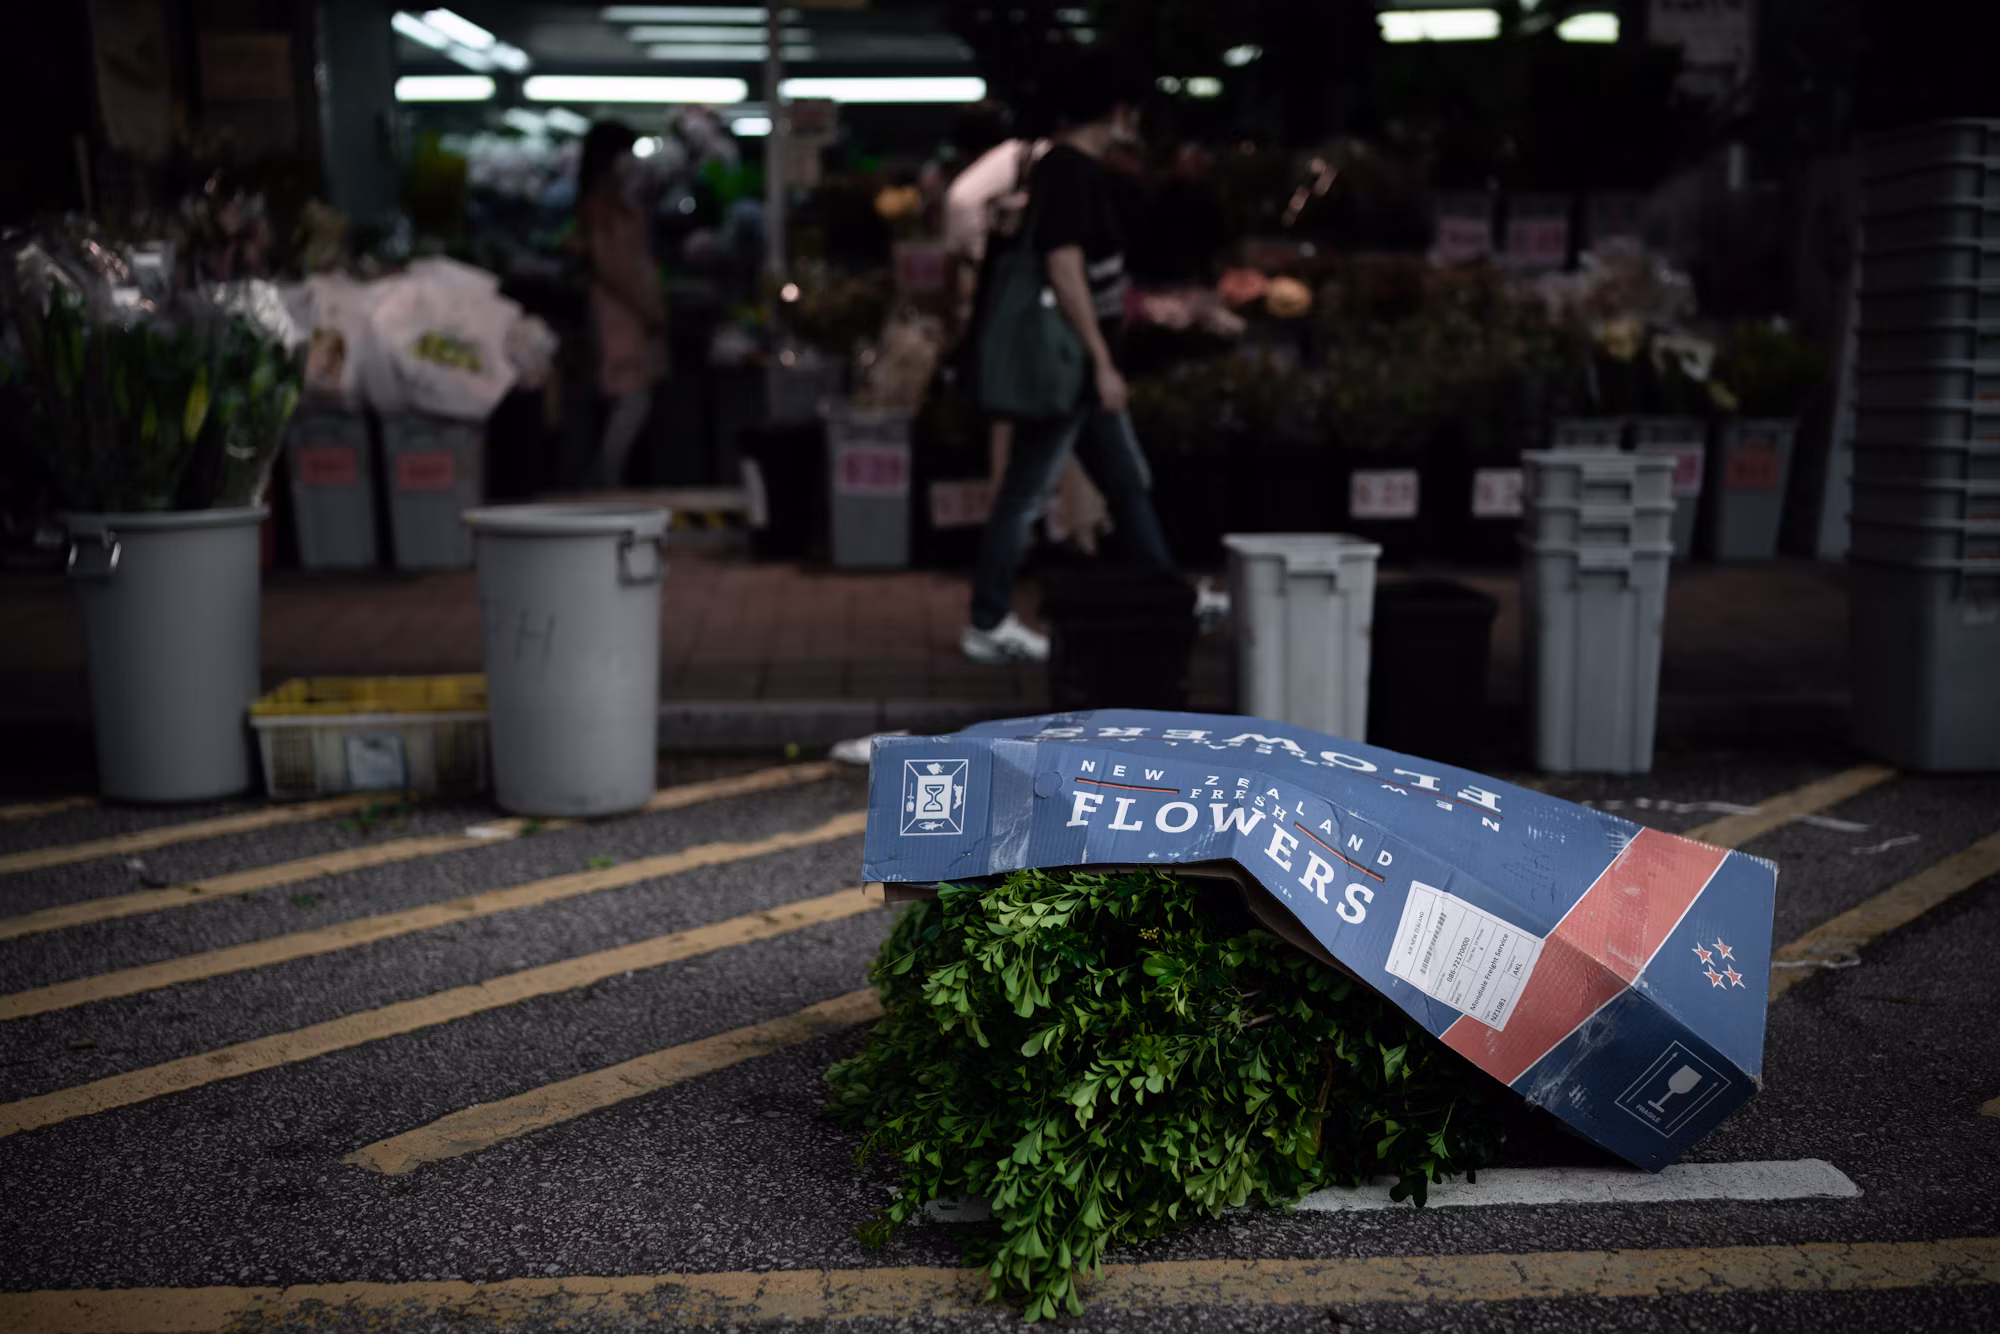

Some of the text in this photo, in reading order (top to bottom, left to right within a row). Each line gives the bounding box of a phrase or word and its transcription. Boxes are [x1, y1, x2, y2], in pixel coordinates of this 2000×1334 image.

[1080, 760, 1393, 867] NEW ZEALAND
[1189, 788, 1288, 823] FRESH
[1066, 790, 1375, 925] FLOWERS
[1414, 911, 1424, 934] ZEALAND
[1446, 936, 1470, 983] 086-72170000
[1470, 933, 1509, 1011] Mondiale Freight Service
[1513, 963, 1522, 976] AKL
[1490, 998, 1506, 1022] NZ1081
[1635, 1104, 1661, 1123] FRAGILE
